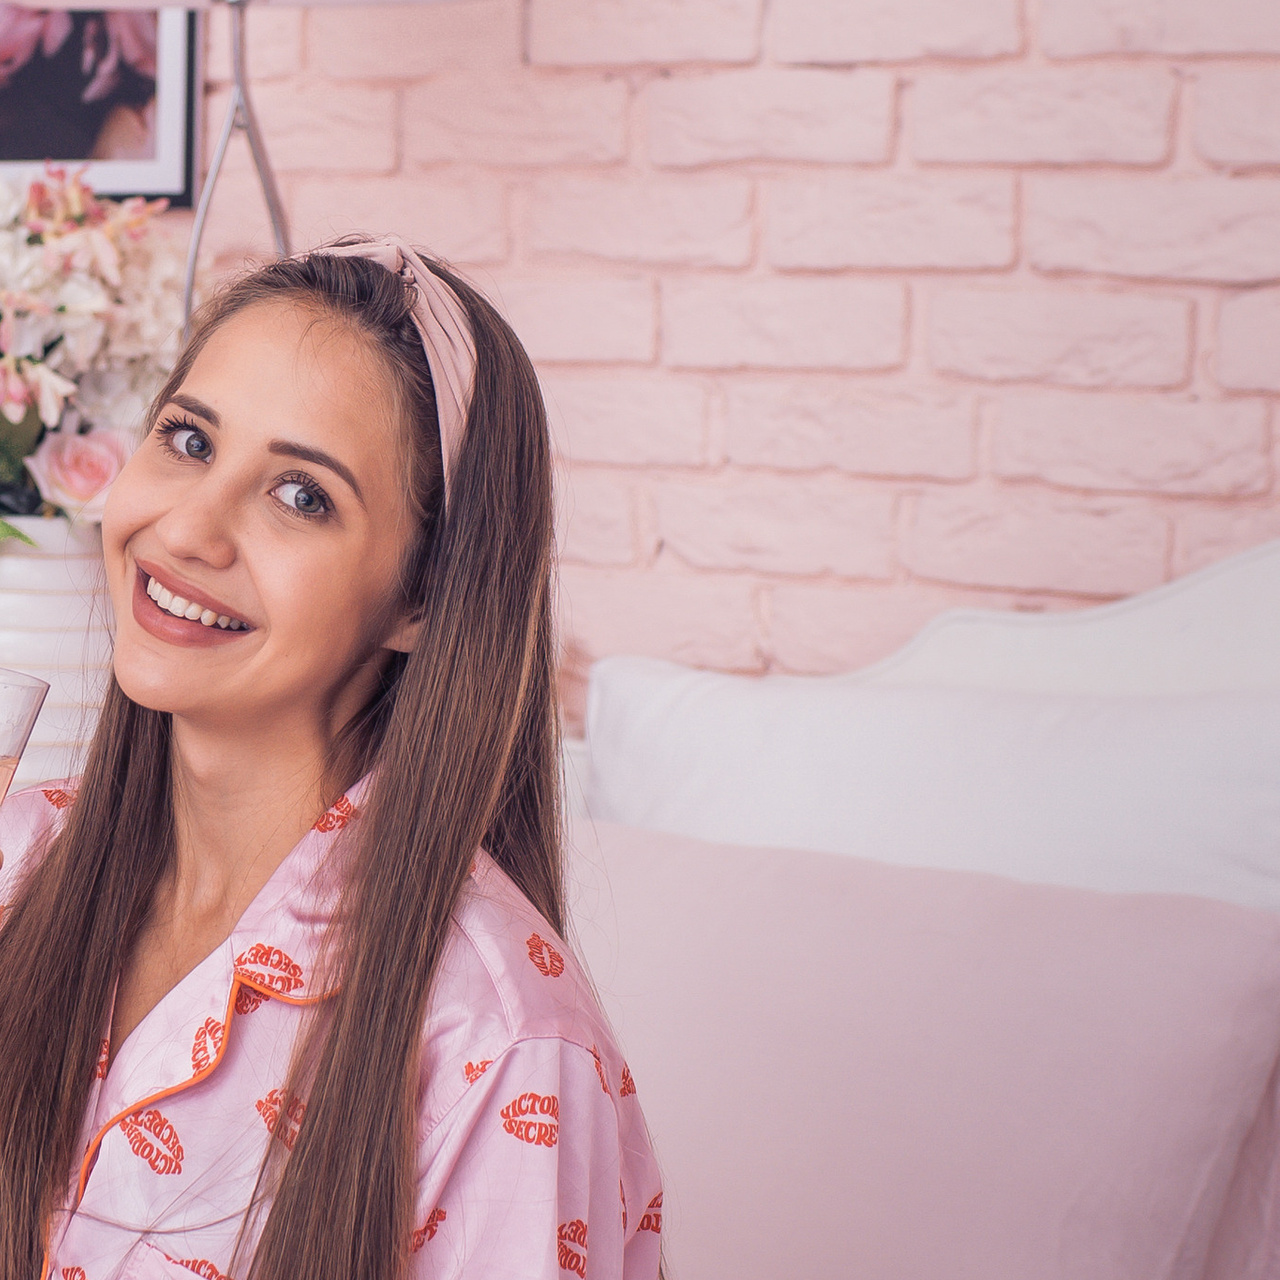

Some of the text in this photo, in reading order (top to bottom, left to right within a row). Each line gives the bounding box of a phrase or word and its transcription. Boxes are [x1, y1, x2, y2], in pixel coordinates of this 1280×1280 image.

[233, 943, 304, 979] SECRET
[190, 1025, 217, 1080] SECR
[130, 1109, 185, 1164] SECRET
[503, 1118, 559, 1148] SECRE
